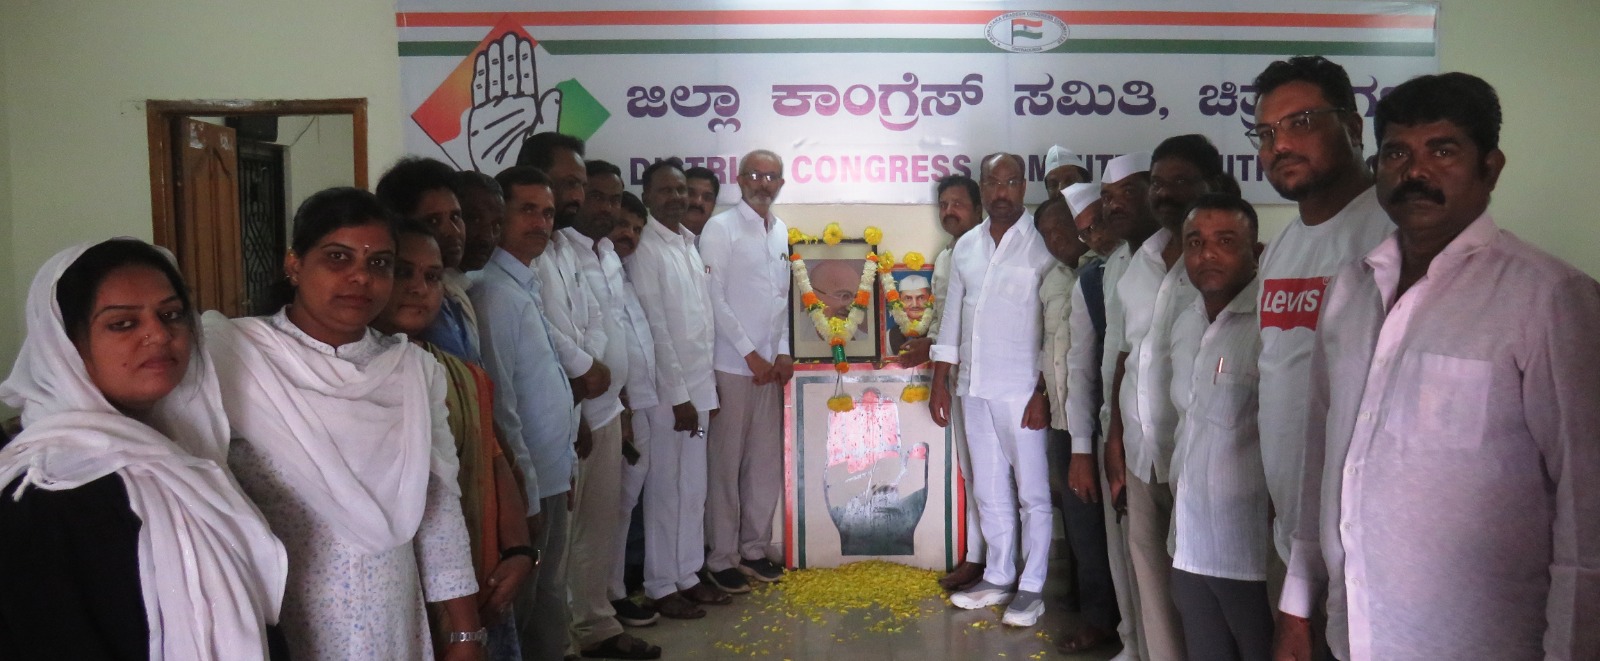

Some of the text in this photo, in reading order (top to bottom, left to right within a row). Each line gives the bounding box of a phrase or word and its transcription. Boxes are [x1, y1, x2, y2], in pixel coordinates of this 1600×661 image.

[626, 85, 742, 133] ಜಿಲ್ಲಾ
[771, 72, 984, 132] ಕಾಂಗ್ರೆಸ್
[1013, 73, 1169, 121] ಸಮಿತಿ,
[791, 154, 972, 184] CONGRESS
